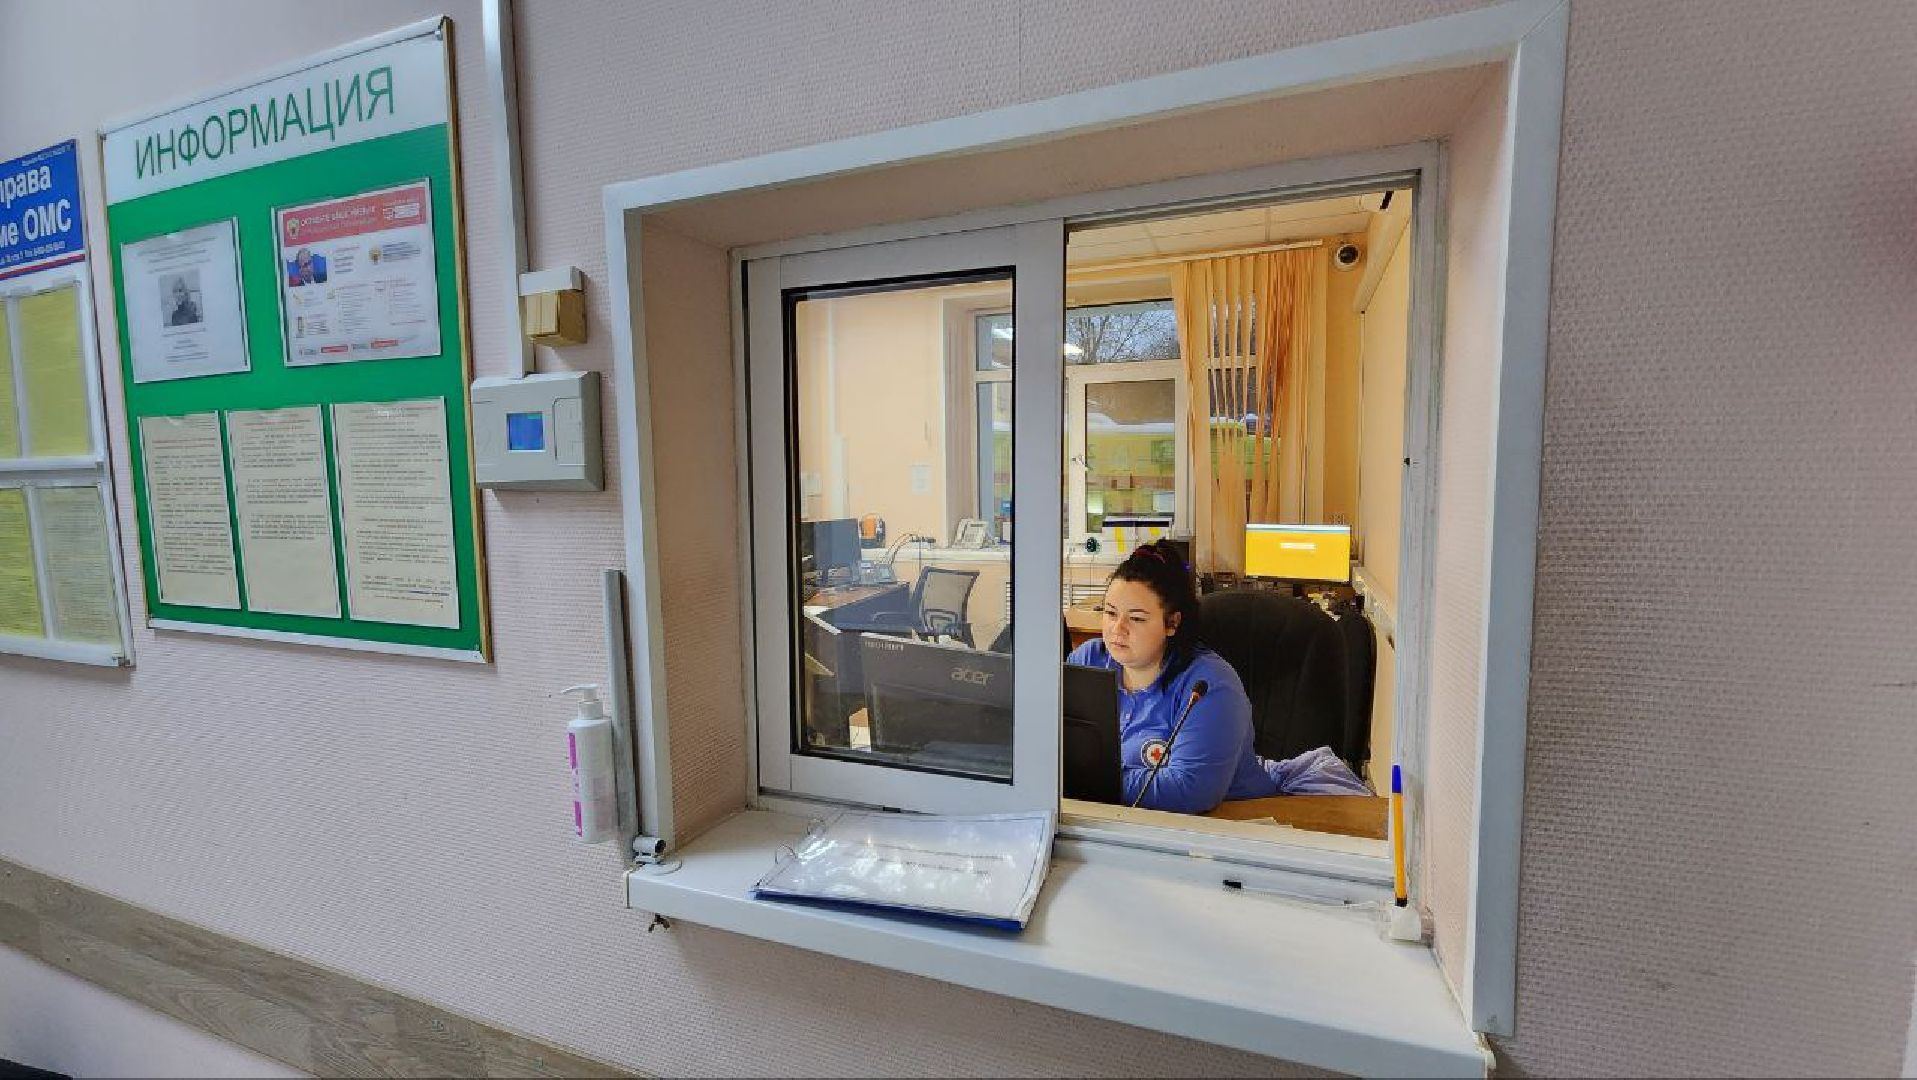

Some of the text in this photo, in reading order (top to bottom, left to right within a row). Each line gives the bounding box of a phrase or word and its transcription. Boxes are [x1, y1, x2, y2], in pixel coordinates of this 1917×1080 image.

[135, 65, 395, 180] ИНФОРМАЦИЯ
[24, 198, 72, 242] ОМС
[951, 667, 995, 686] acer
